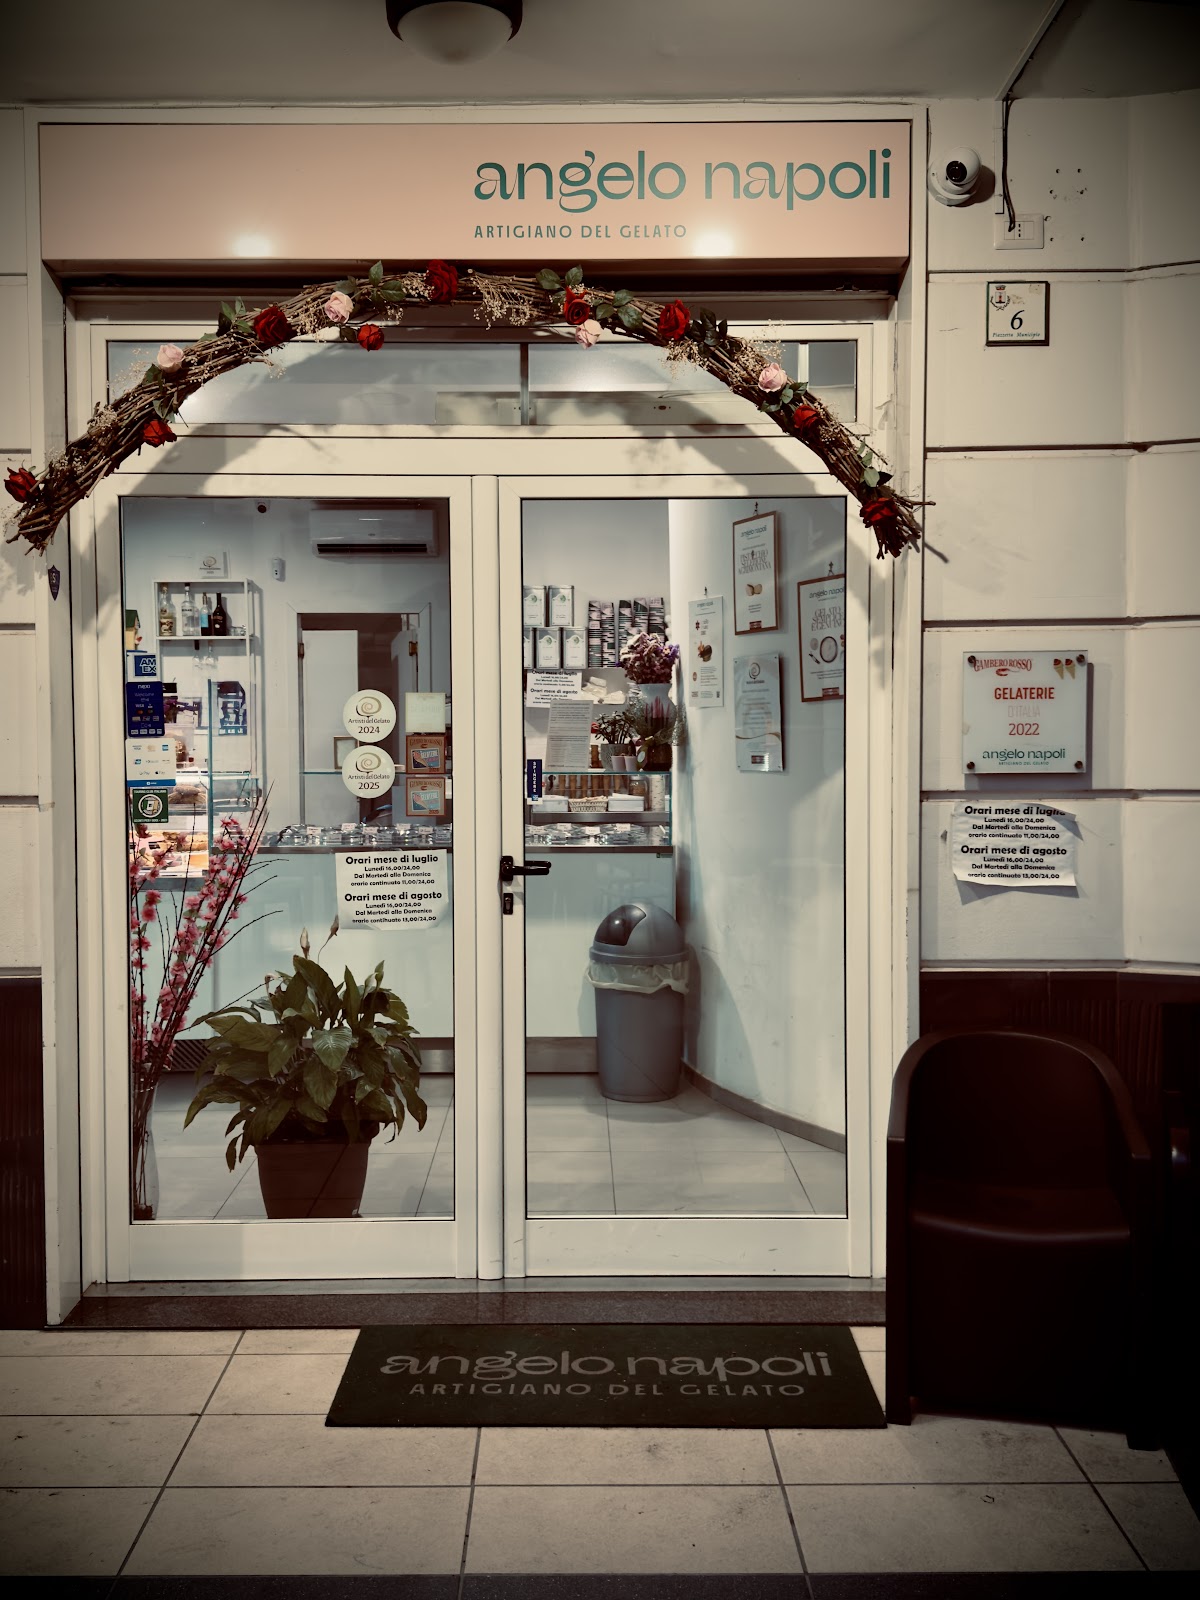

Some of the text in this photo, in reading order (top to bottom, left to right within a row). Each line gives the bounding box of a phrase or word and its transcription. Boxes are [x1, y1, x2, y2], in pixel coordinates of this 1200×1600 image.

[474, 148, 891, 213] angelo napoli
[474, 224, 687, 239] ARTIGIANO DEL GELATO
[1010, 310, 1025, 330] 6
[809, 589, 828, 598] angelo
[974, 659, 1032, 672] GAMBERO ROSSO
[994, 687, 1054, 700] GELATERIE
[1008, 706, 1040, 718] D'ITALIA
[358, 726, 380, 734] 2024
[1009, 723, 1039, 735] 2022
[983, 749, 1065, 761] angelo napoli
[965, 805, 992, 815] Orari
[995, 807, 1020, 815] mese
[1023, 806, 1033, 815] di
[961, 845, 988, 854] Orari
[1020, 846, 1029, 854] di
[1033, 847, 1067, 856] agosto
[346, 856, 370, 864] Orari
[400, 855, 409, 863] di
[412, 855, 438, 864] luglio
[411, 892, 442, 900] agosto
[379, 1350, 833, 1382] angelo napoli
[408, 1382, 806, 1397] ARTIGIANO DEL GELATO
